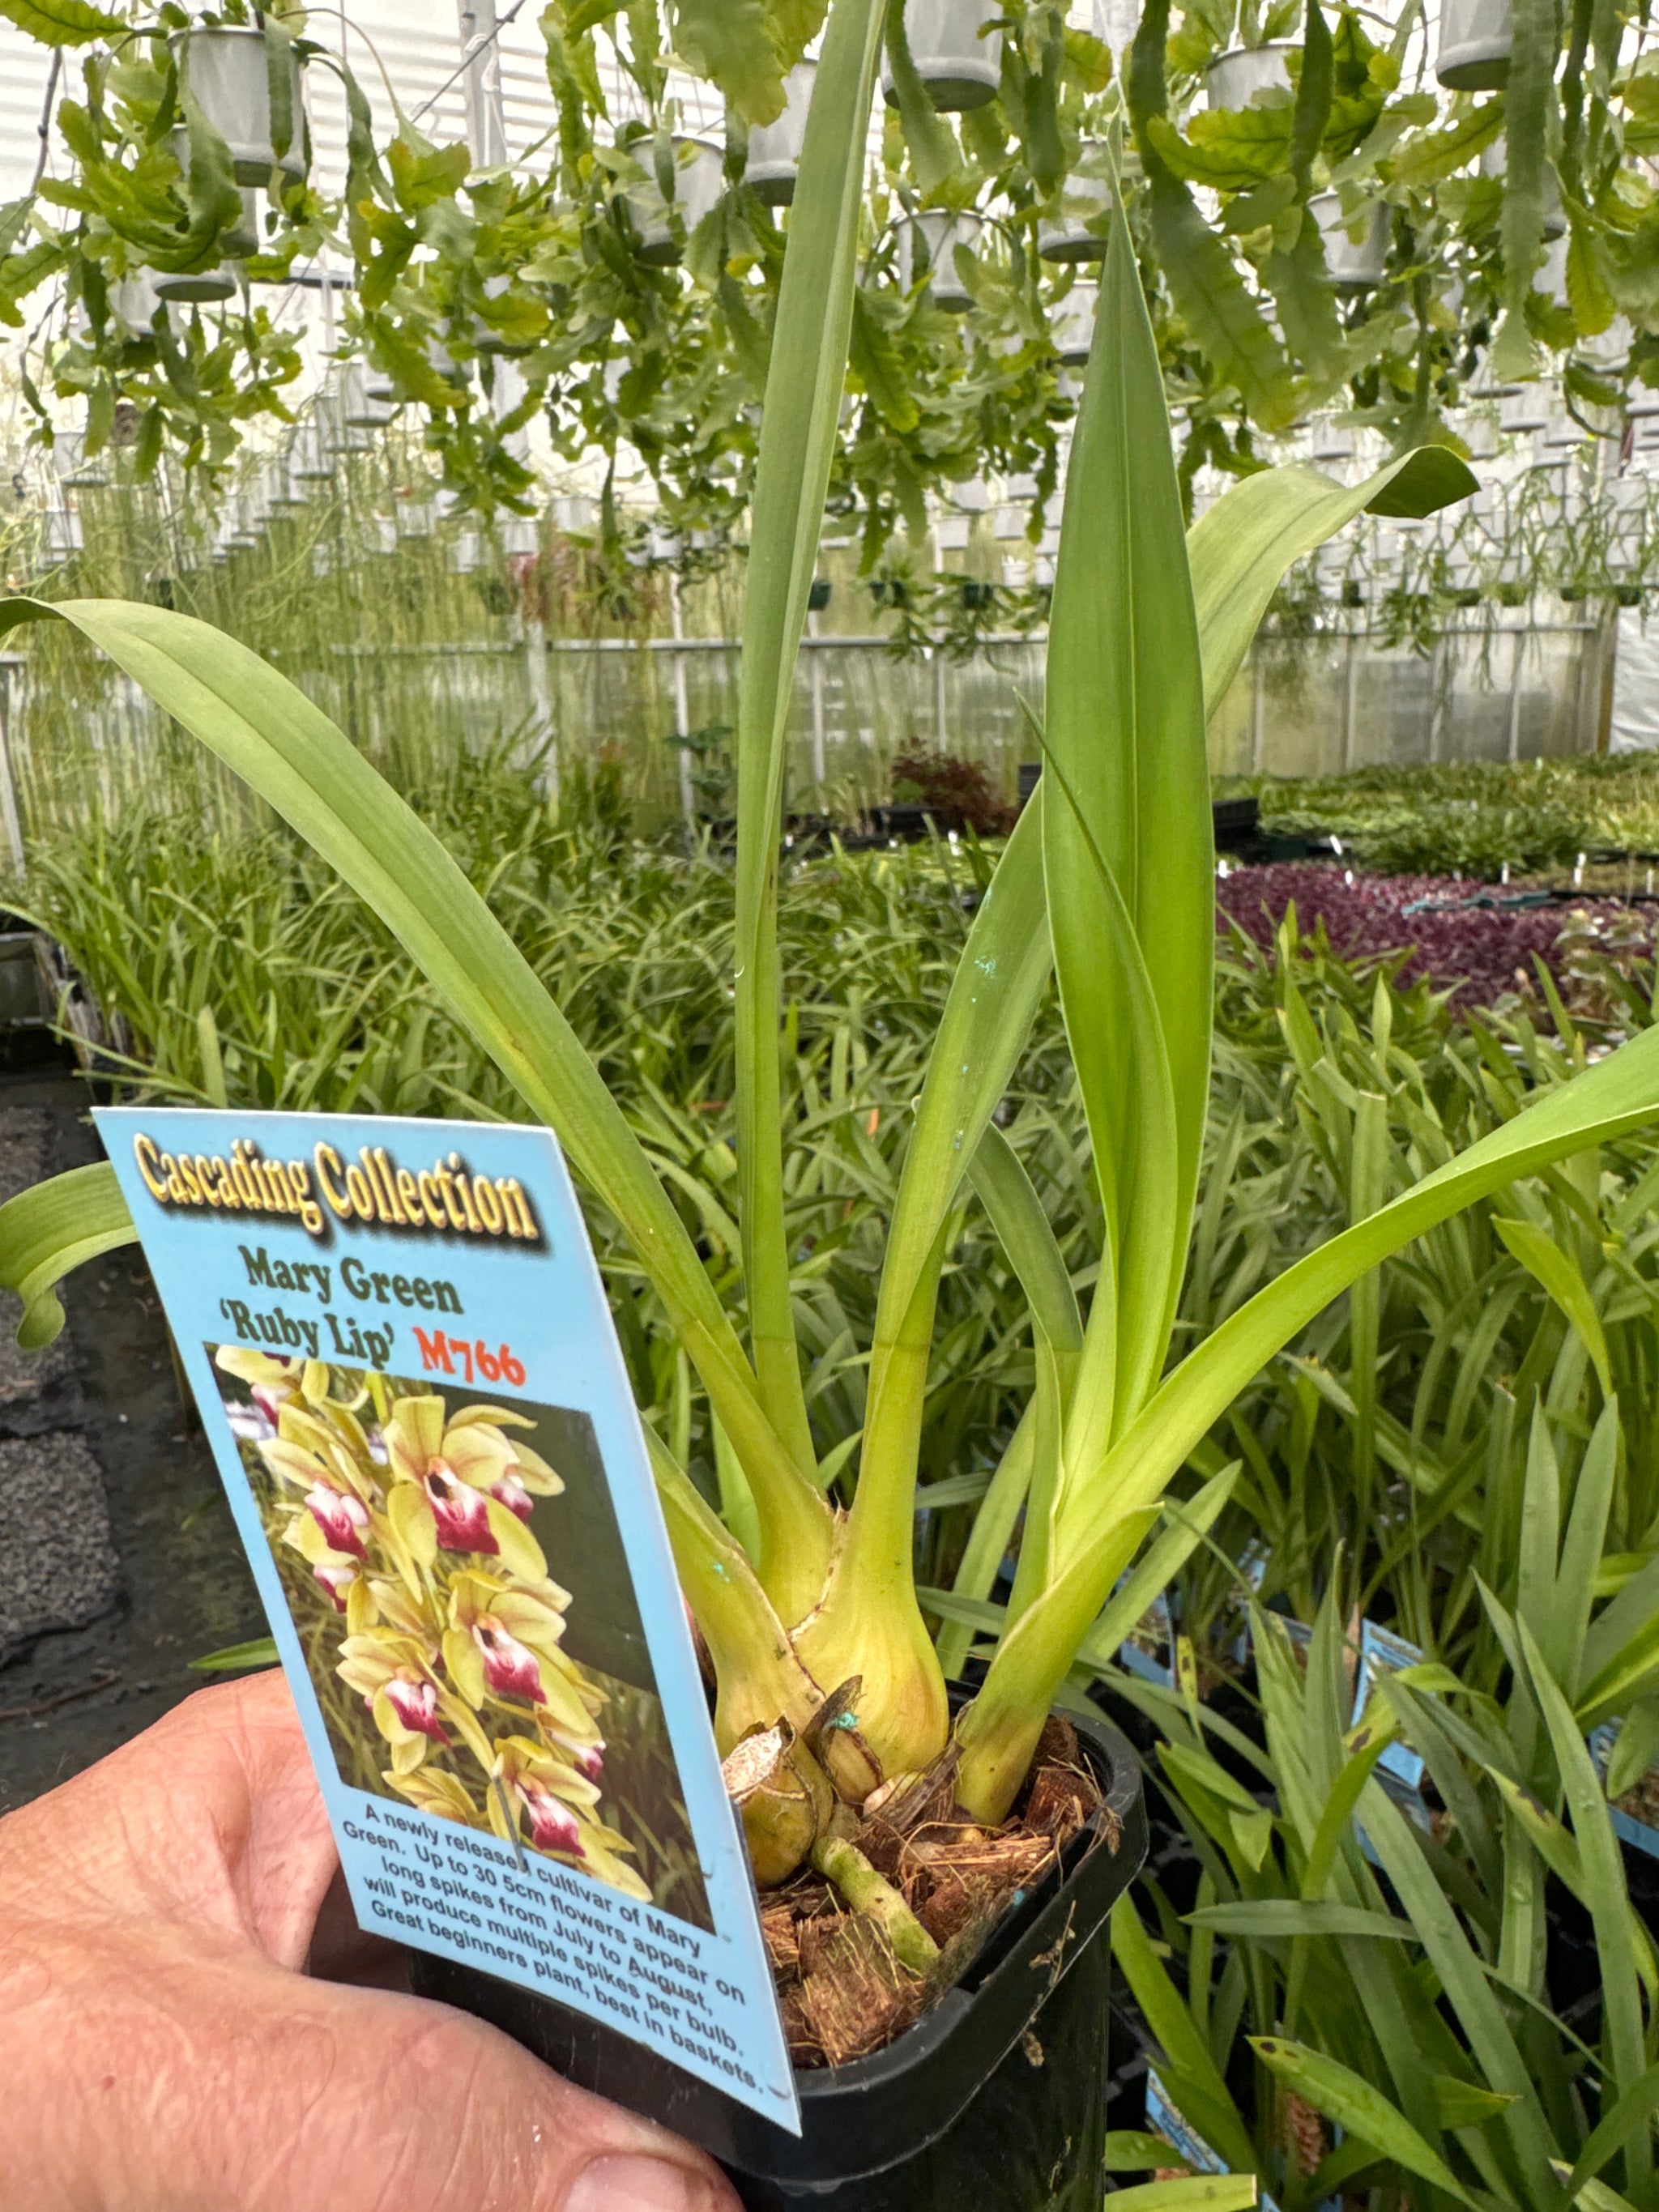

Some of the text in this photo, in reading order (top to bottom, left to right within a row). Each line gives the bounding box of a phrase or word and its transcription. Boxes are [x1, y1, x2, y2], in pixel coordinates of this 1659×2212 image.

[134, 1132, 539, 1240] Cascading Collection
[220, 1298, 527, 1387] 'Ruby Lip' M766
[238, 1245, 464, 1315] Mary Green
[343, 1821, 745, 2005] Green. Up to 30 5cm flowers appear on
[366, 1804, 380, 1822] A
[384, 1813, 438, 1845] newly
[537, 1868, 612, 1912] cultivar
[620, 1905, 640, 1926] of
[646, 1914, 701, 1958] Mary
[382, 1856, 713, 2017] long spikes from July to August,
[364, 1877, 744, 2056] will produce multiple spikes per bulb.
[372, 1900, 764, 2094] Great beginners plant, best in baskets.
